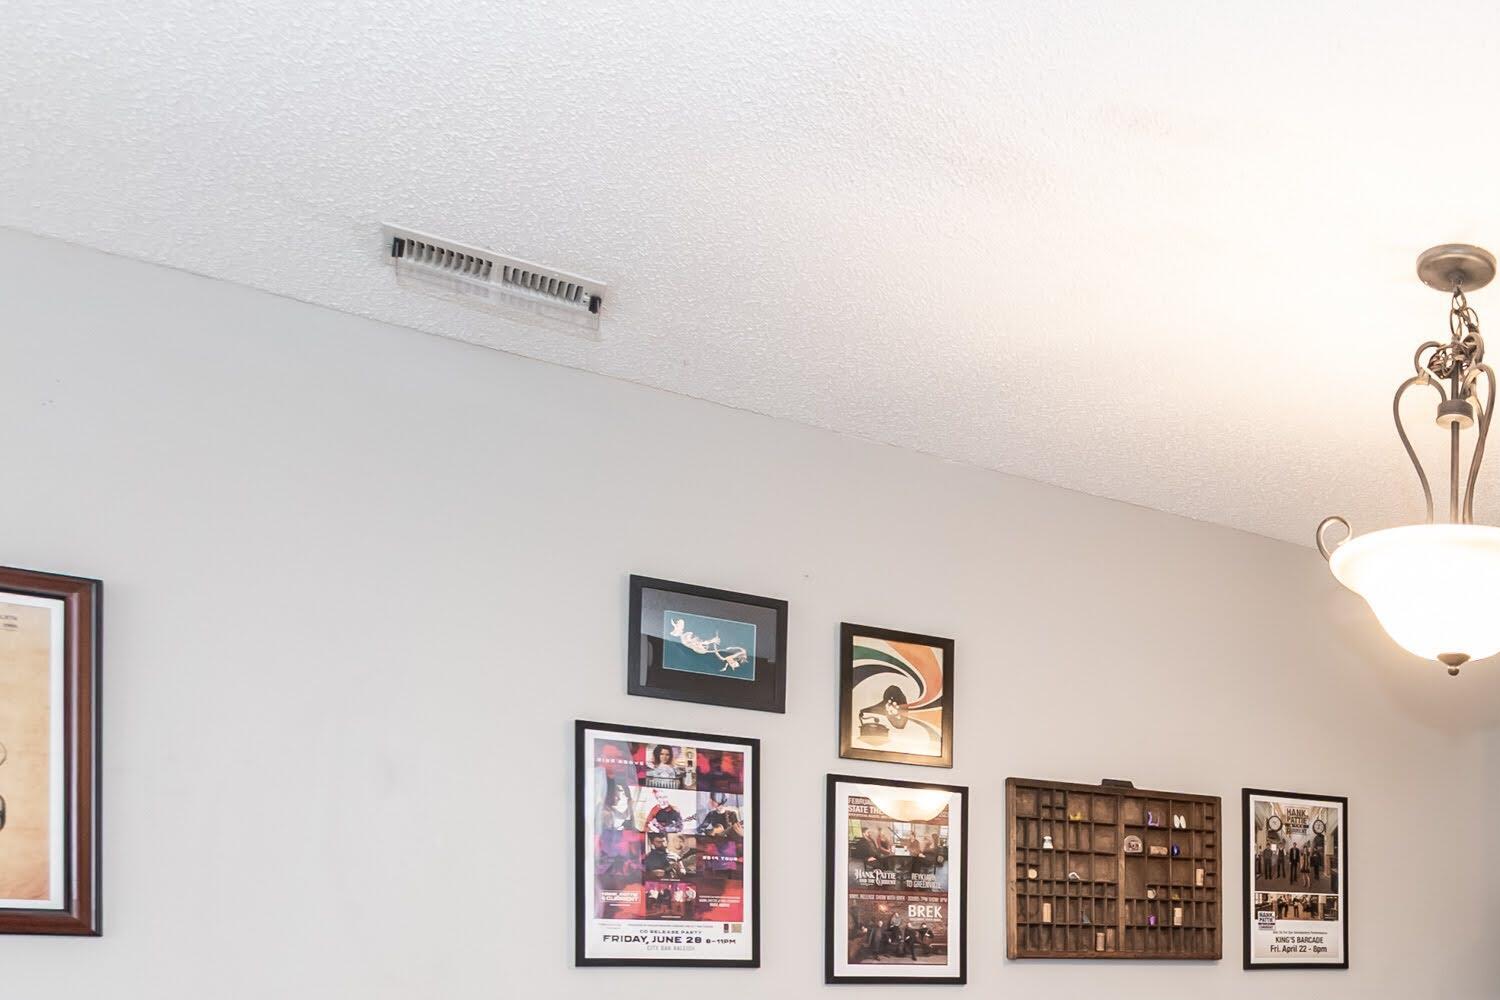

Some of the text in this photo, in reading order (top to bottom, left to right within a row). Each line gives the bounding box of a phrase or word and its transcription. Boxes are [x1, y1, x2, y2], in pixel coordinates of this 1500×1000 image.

[848, 805, 868, 813] STATE
[908, 905, 942, 918] BREK
[603, 935, 649, 944] FRIDAY,
[652, 936, 682, 944] JUNE
[686, 936, 702, 944] 28
[1275, 936, 1323, 944] KING'S BARCADE
[1282, 945, 1297, 954] April
[1299, 945, 1307, 953] 22
[1313, 945, 1328, 954] 8pm
